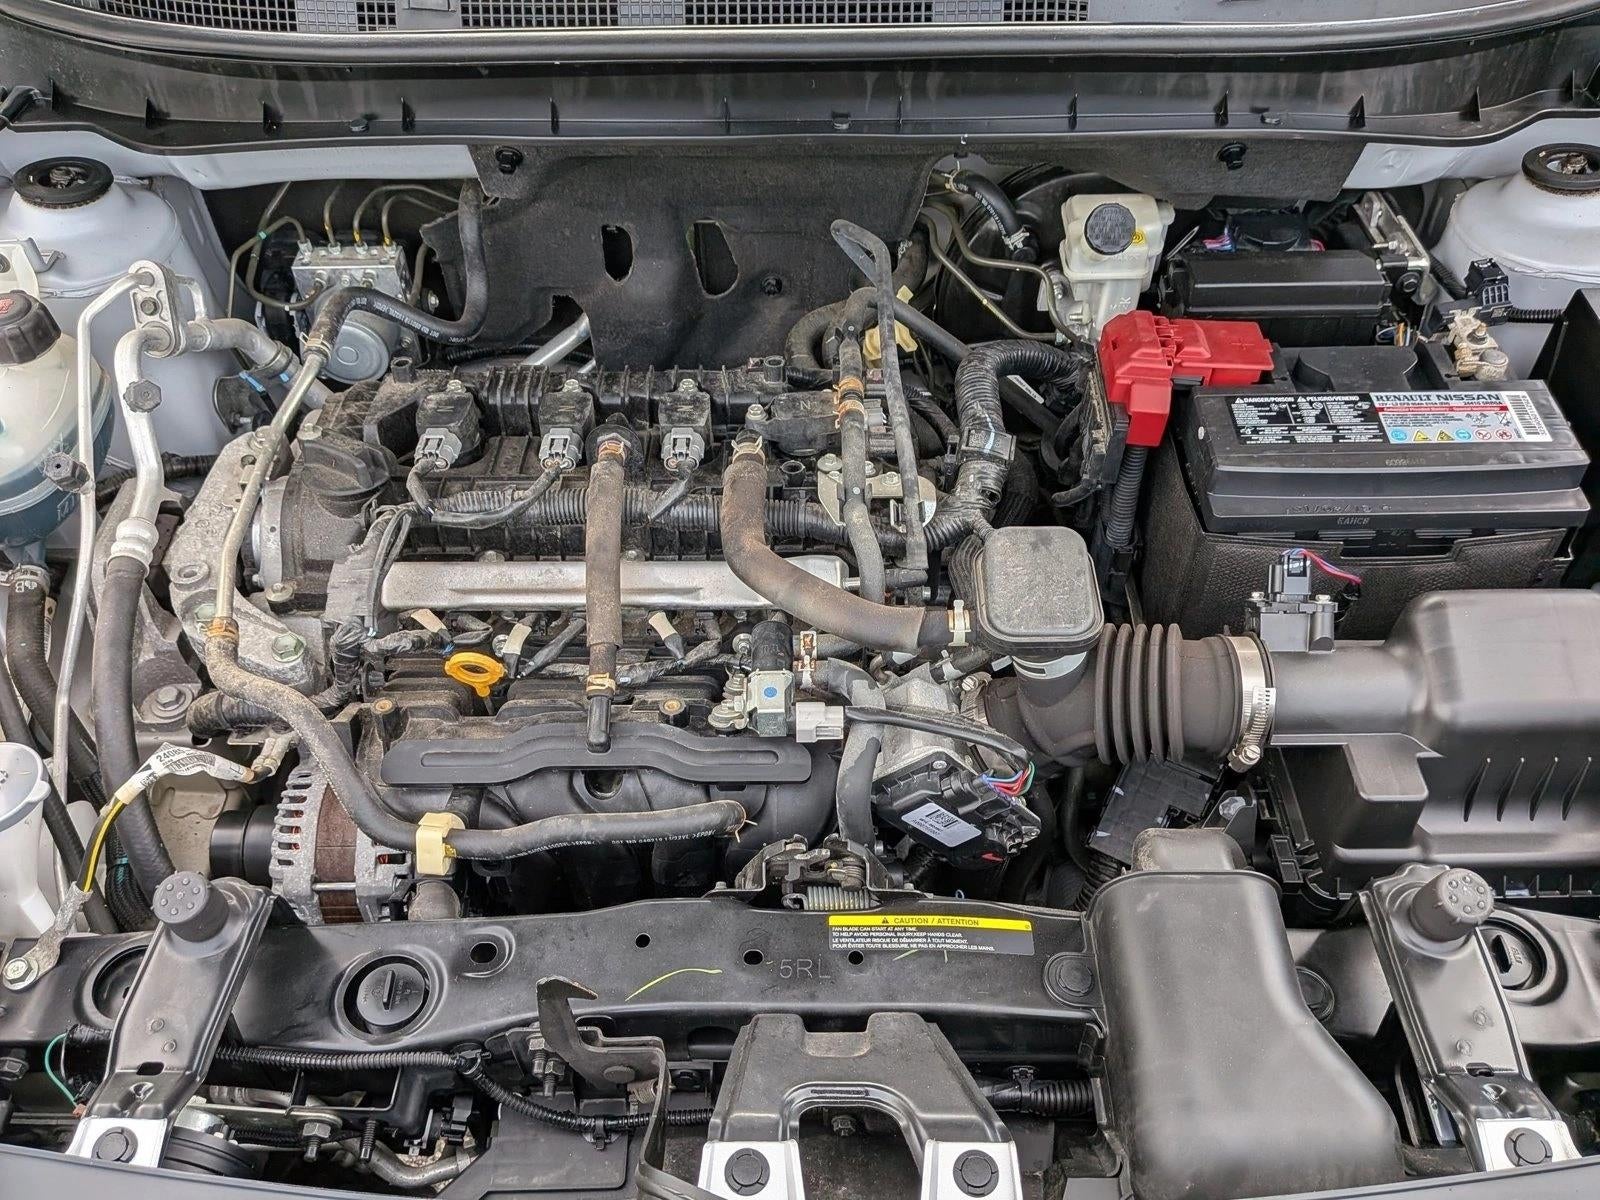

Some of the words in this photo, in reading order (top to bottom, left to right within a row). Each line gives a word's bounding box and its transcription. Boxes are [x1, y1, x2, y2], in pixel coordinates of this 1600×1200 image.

[1375, 394, 1433, 402] RENAULT
[1437, 393, 1501, 401] NISSAN
[937, 918, 979, 926] ATTENTION
[899, 936, 927, 944] DÉMARRER
[779, 958, 831, 979] 5RL
